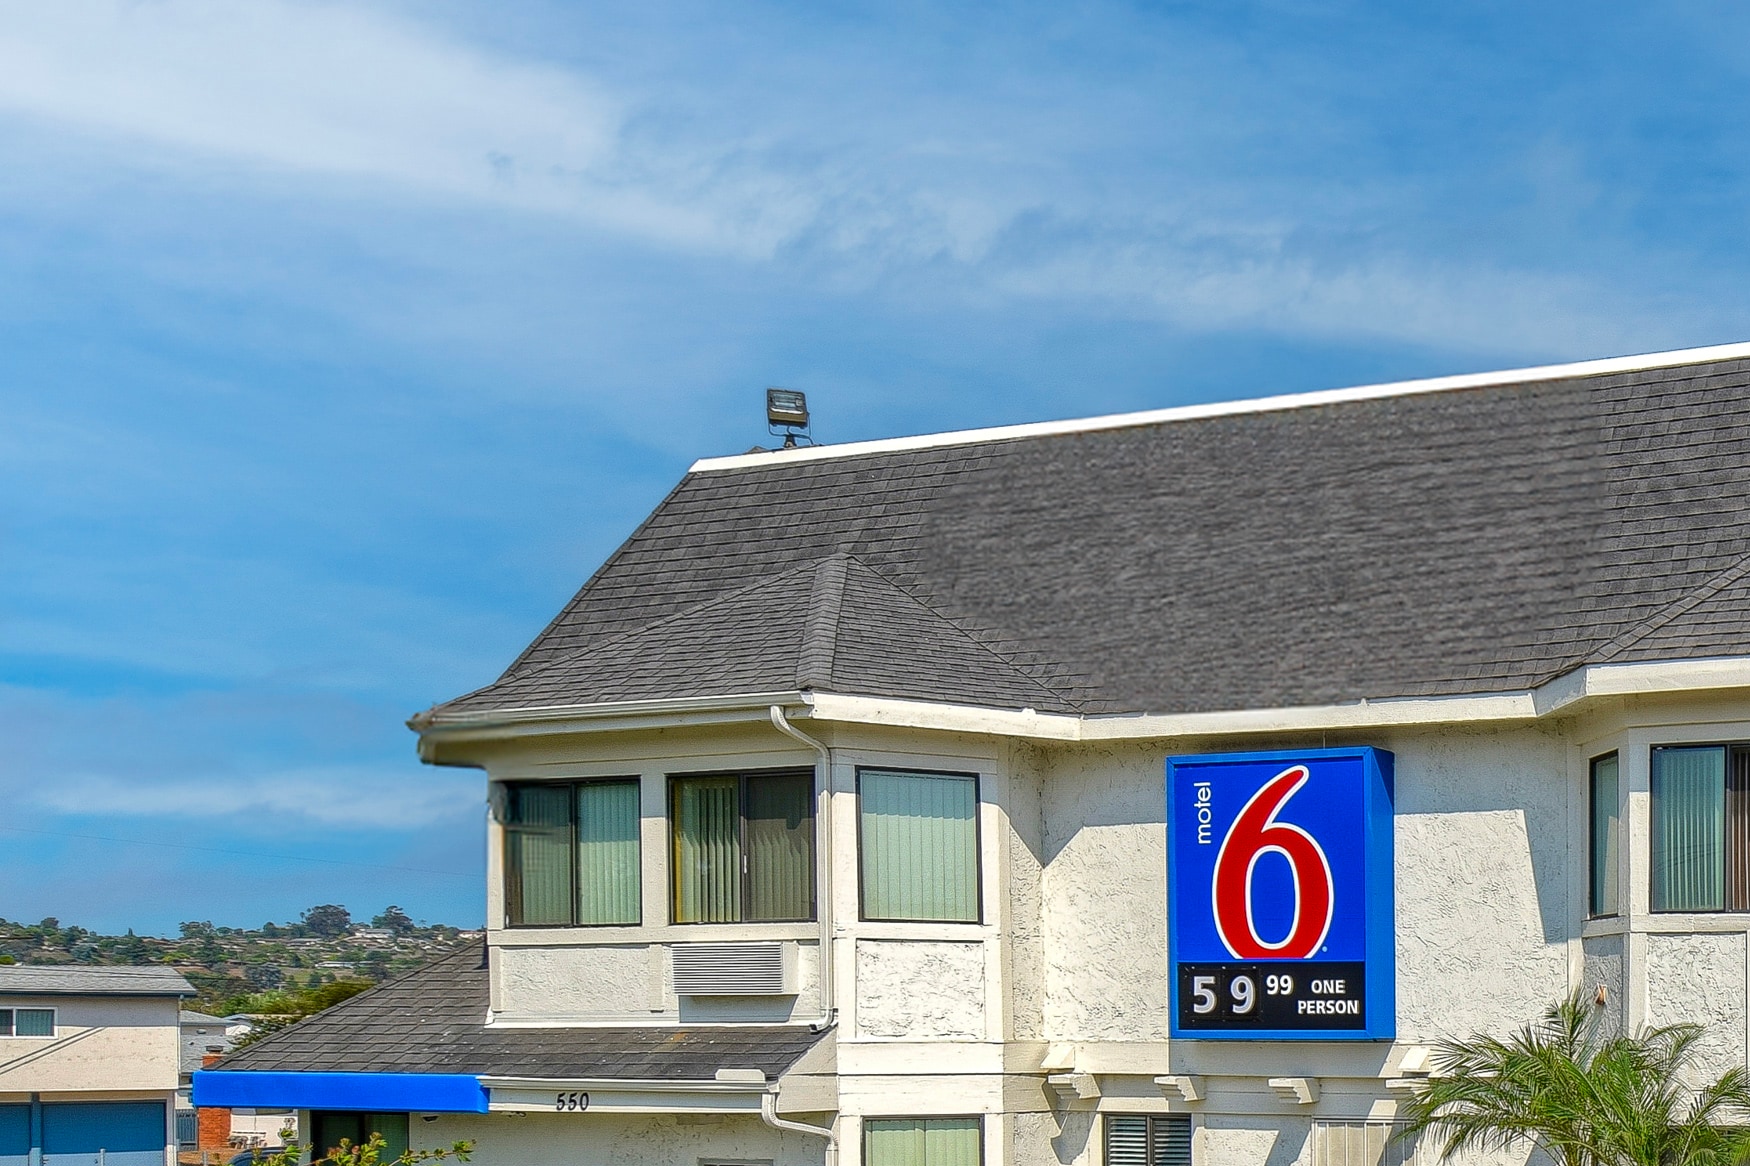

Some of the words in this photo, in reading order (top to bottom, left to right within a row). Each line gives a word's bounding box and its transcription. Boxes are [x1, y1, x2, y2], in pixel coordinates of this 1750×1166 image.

[1194, 782, 1211, 844] motel
[1213, 765, 1334, 959] 6
[1266, 975, 1293, 995] 99
[1311, 980, 1345, 994] ONE
[1298, 1000, 1359, 1014] PERSON
[556, 1092, 590, 1111] 550
